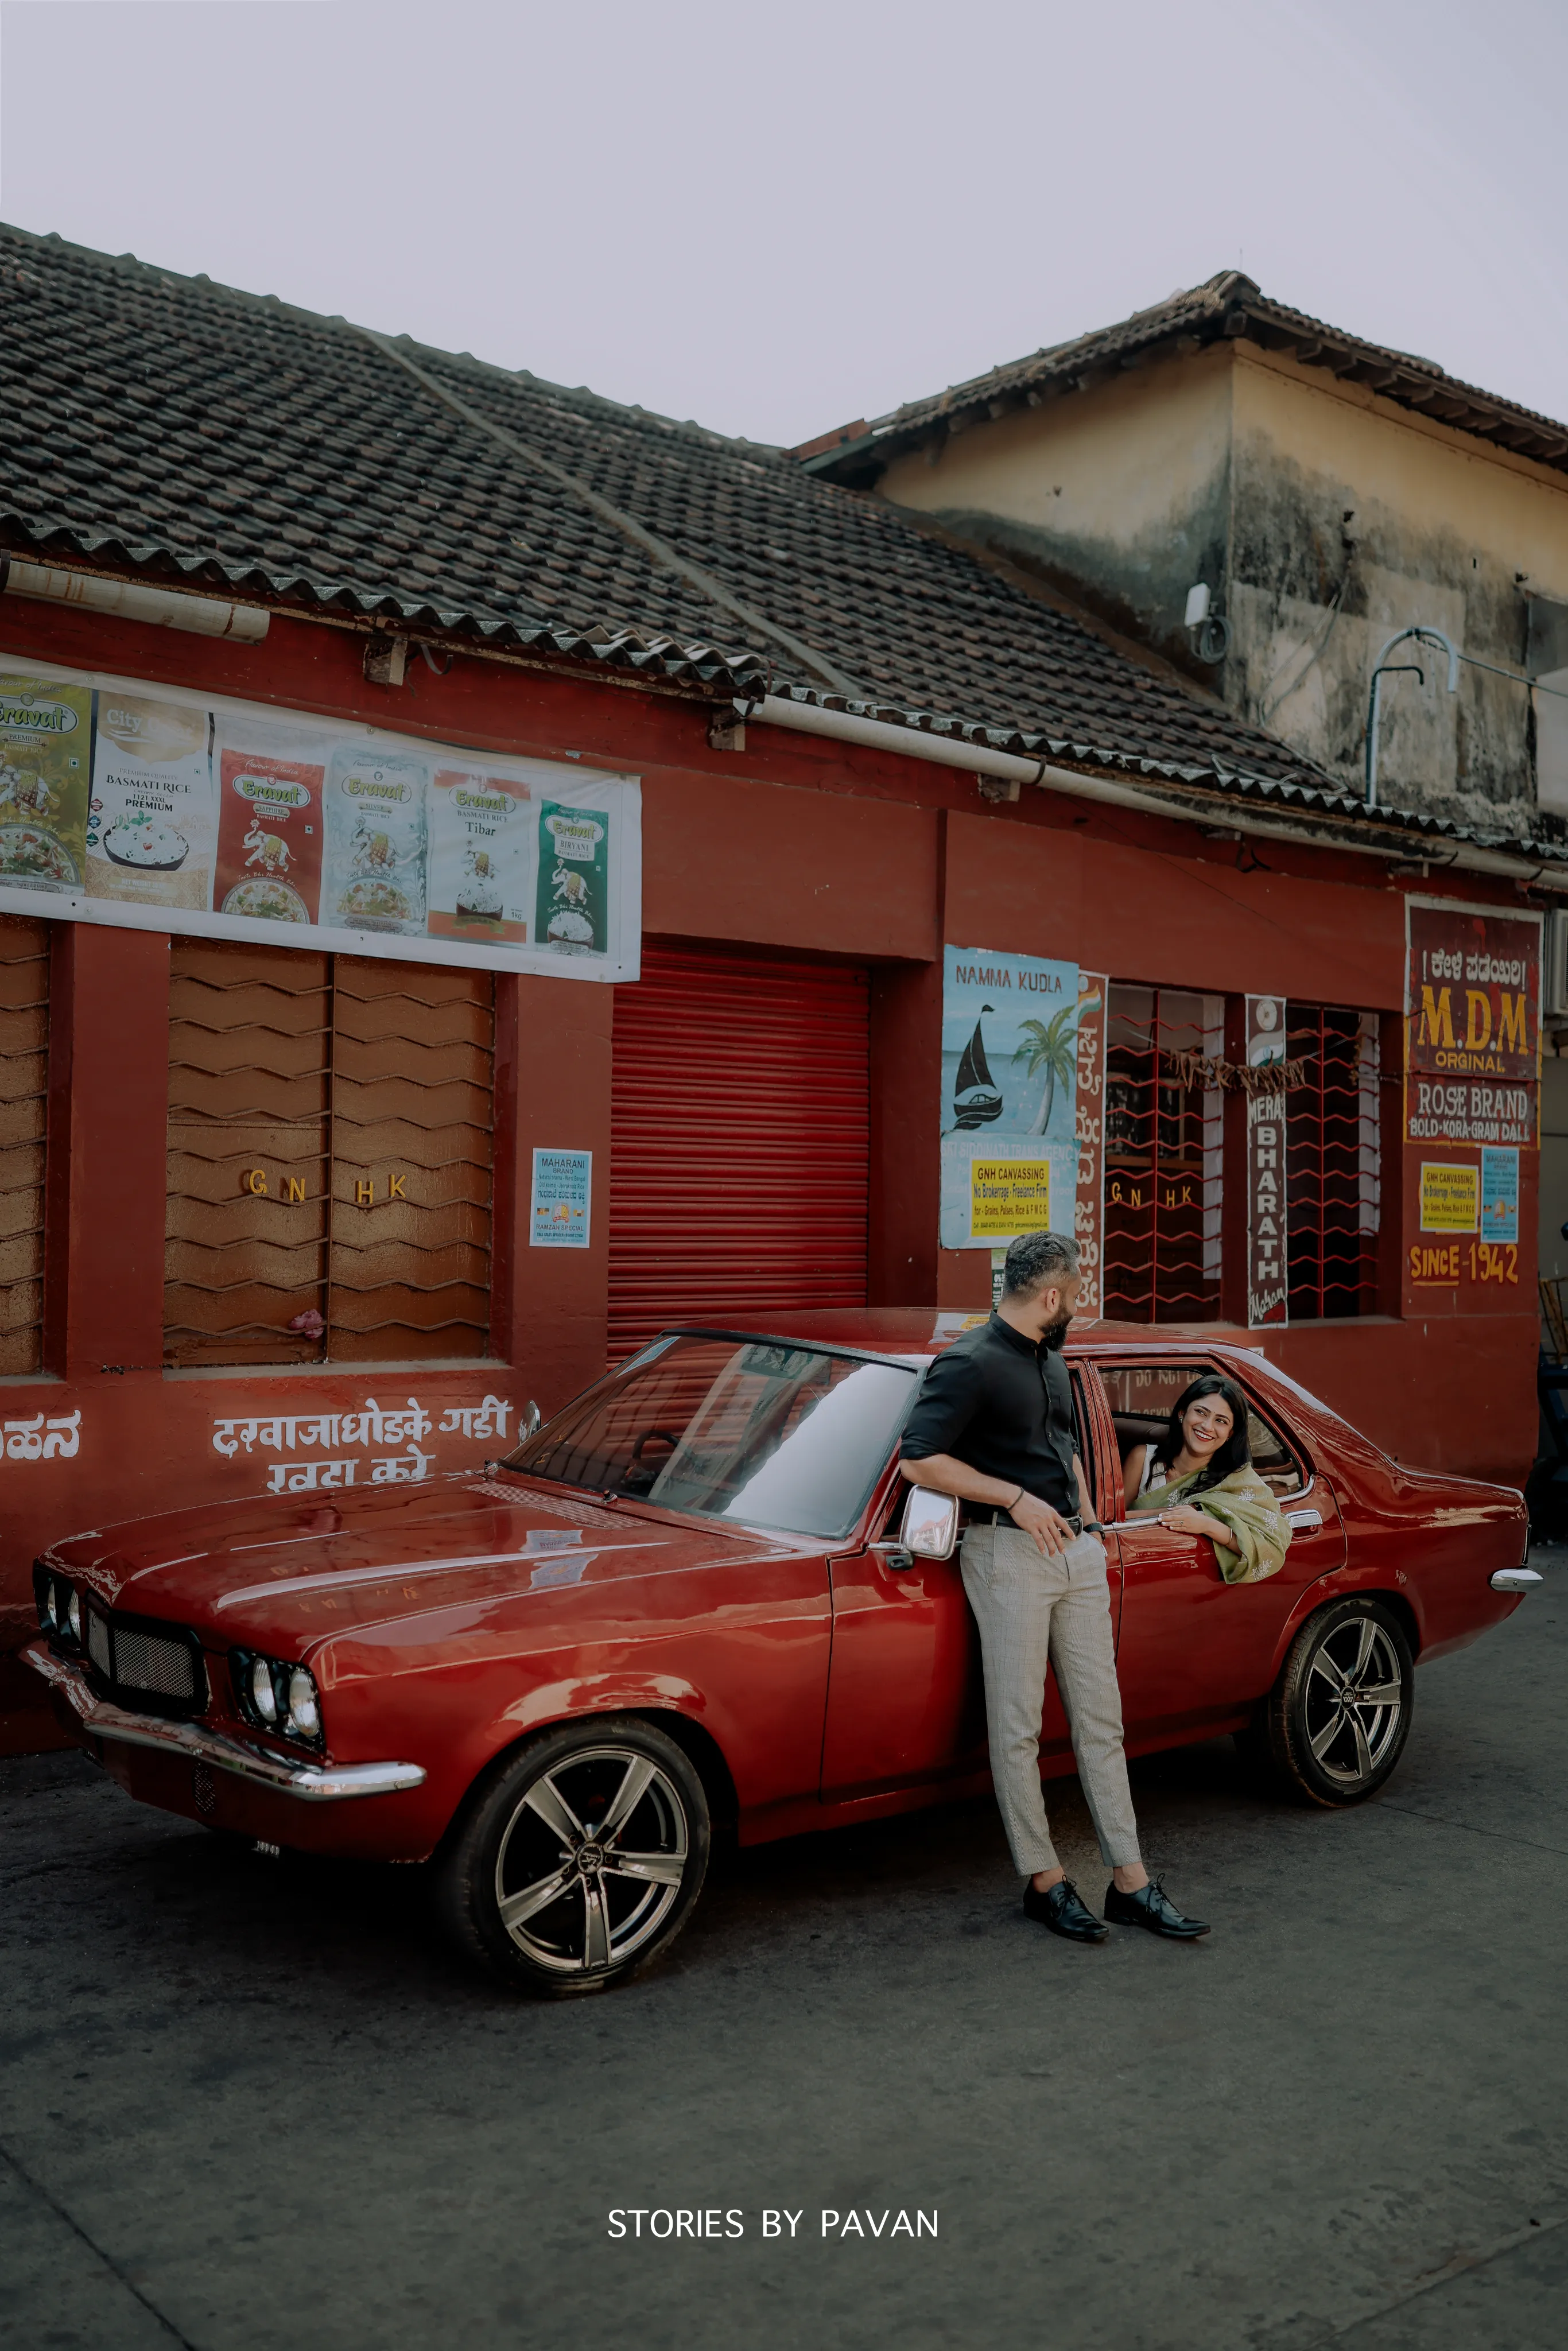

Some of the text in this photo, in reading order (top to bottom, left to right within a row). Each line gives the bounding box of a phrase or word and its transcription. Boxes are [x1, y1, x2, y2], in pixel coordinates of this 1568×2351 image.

[0, 701, 67, 731] ravat
[107, 709, 143, 733] City
[9, 734, 41, 743] PREMIUM
[245, 759, 299, 775] Flavour of India
[353, 759, 375, 767] Flavour
[119, 767, 177, 781] PREMIUM QUALITY
[106, 775, 191, 794] BASMATI RICE
[242, 779, 301, 805] Eravat
[349, 778, 406, 801] Eravat
[125, 799, 173, 812] PREMIUM
[456, 790, 508, 811] Eravat
[258, 805, 285, 814] SAPPHIRE
[457, 810, 509, 823] BASMATI RICE
[465, 821, 496, 836] Tibar
[553, 819, 596, 839] Eravat
[560, 840, 588, 851] BIRYANI
[266, 872, 284, 881] Health
[347, 872, 359, 880] Taste
[373, 870, 391, 878] Health
[511, 911, 522, 920] 1kg
[569, 905, 584, 913] Health
[956, 965, 1062, 994] NAMMA KUDLA
[1418, 984, 1528, 1056] M.D.M
[1418, 1082, 1527, 1120] ROSE BRAND
[1249, 1095, 1283, 1123] MERA
[1011, 1144, 1039, 1158] TRANS
[1041, 1144, 1081, 1162] AGENCY
[542, 1158, 585, 1169] MAHARANI
[977, 1168, 996, 1180] GNH
[999, 1168, 1045, 1181] CANVASSING
[1427, 1173, 1438, 1183] GNH
[1439, 1173, 1473, 1186] CANVASSING
[973, 1184, 981, 1198] No
[983, 1183, 1009, 1202] Brokerrage
[1012, 1183, 1035, 1198] Freelance
[1037, 1183, 1047, 1198] Firm
[1015, 1205, 1024, 1215] Rice
[1256, 1126, 1278, 1281] BHARATH
[1410, 1245, 1460, 1279] SINCE
